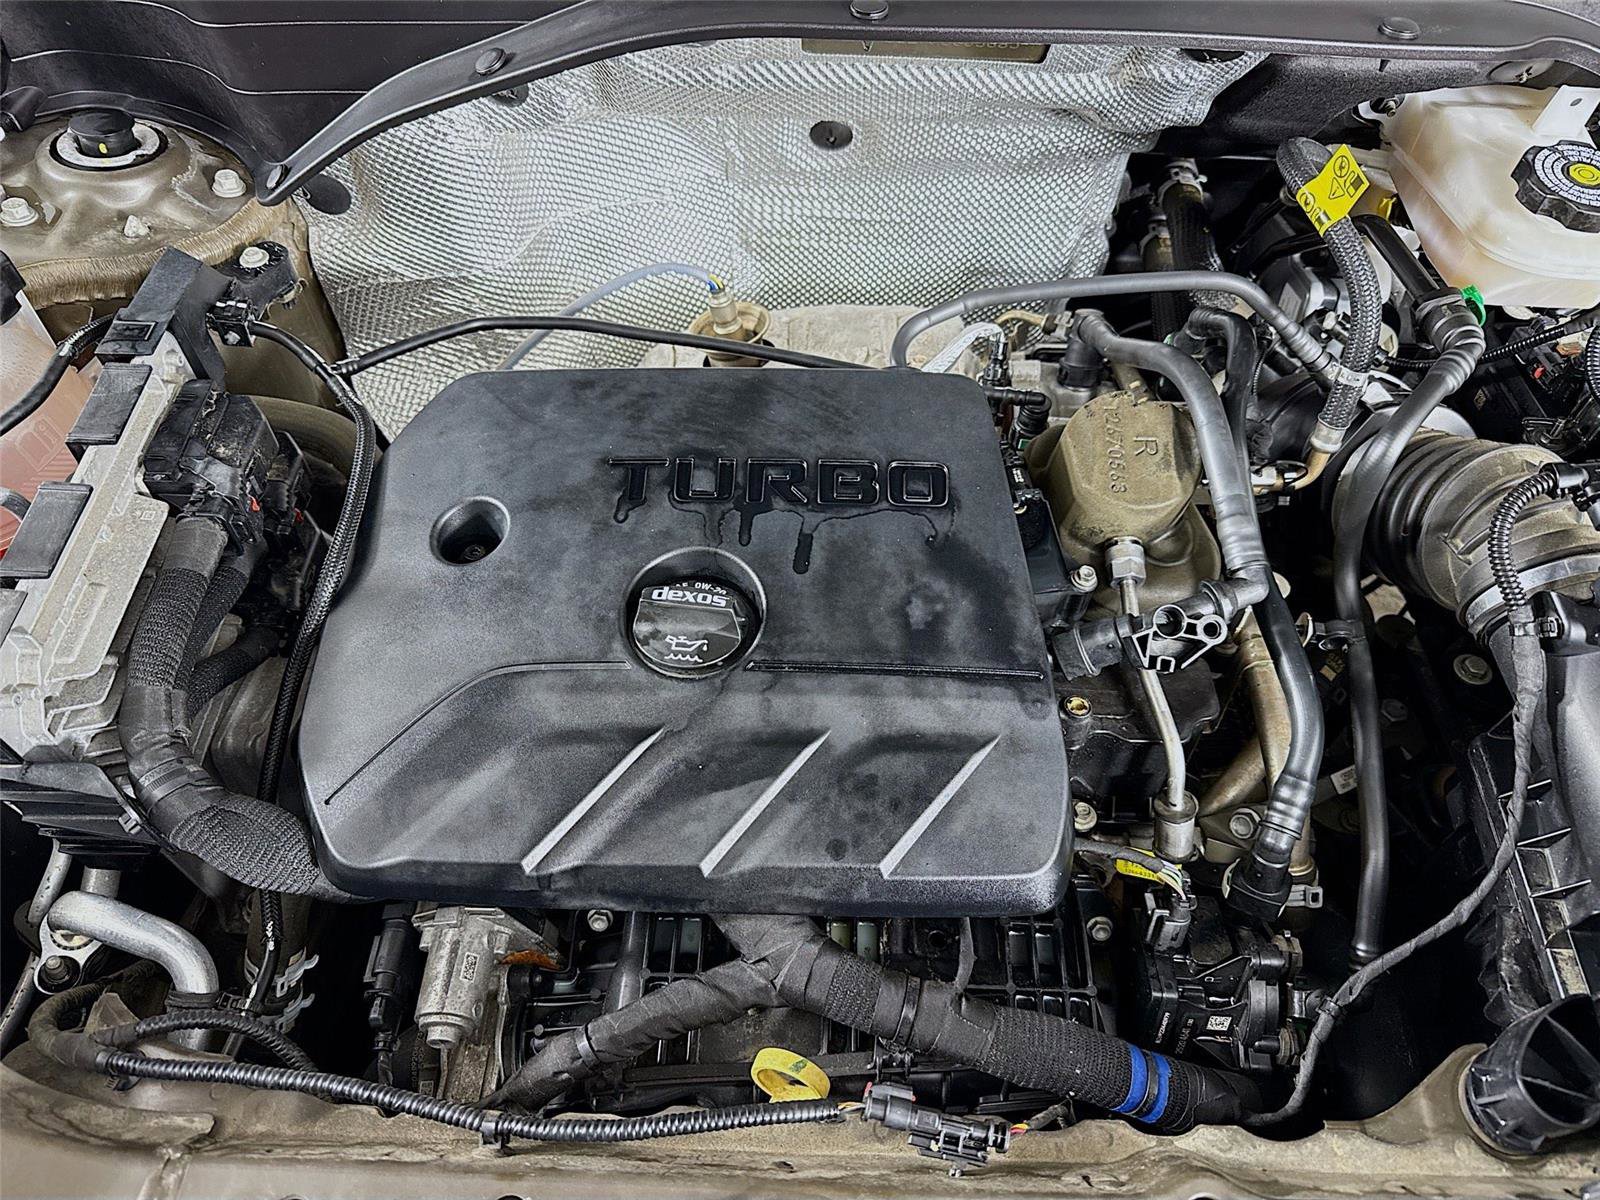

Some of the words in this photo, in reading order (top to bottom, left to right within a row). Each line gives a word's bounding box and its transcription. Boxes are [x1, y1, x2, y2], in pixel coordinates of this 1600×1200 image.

[1134, 435, 1158, 457] R
[607, 456, 952, 508] TURBO
[651, 586, 730, 607] dexos
